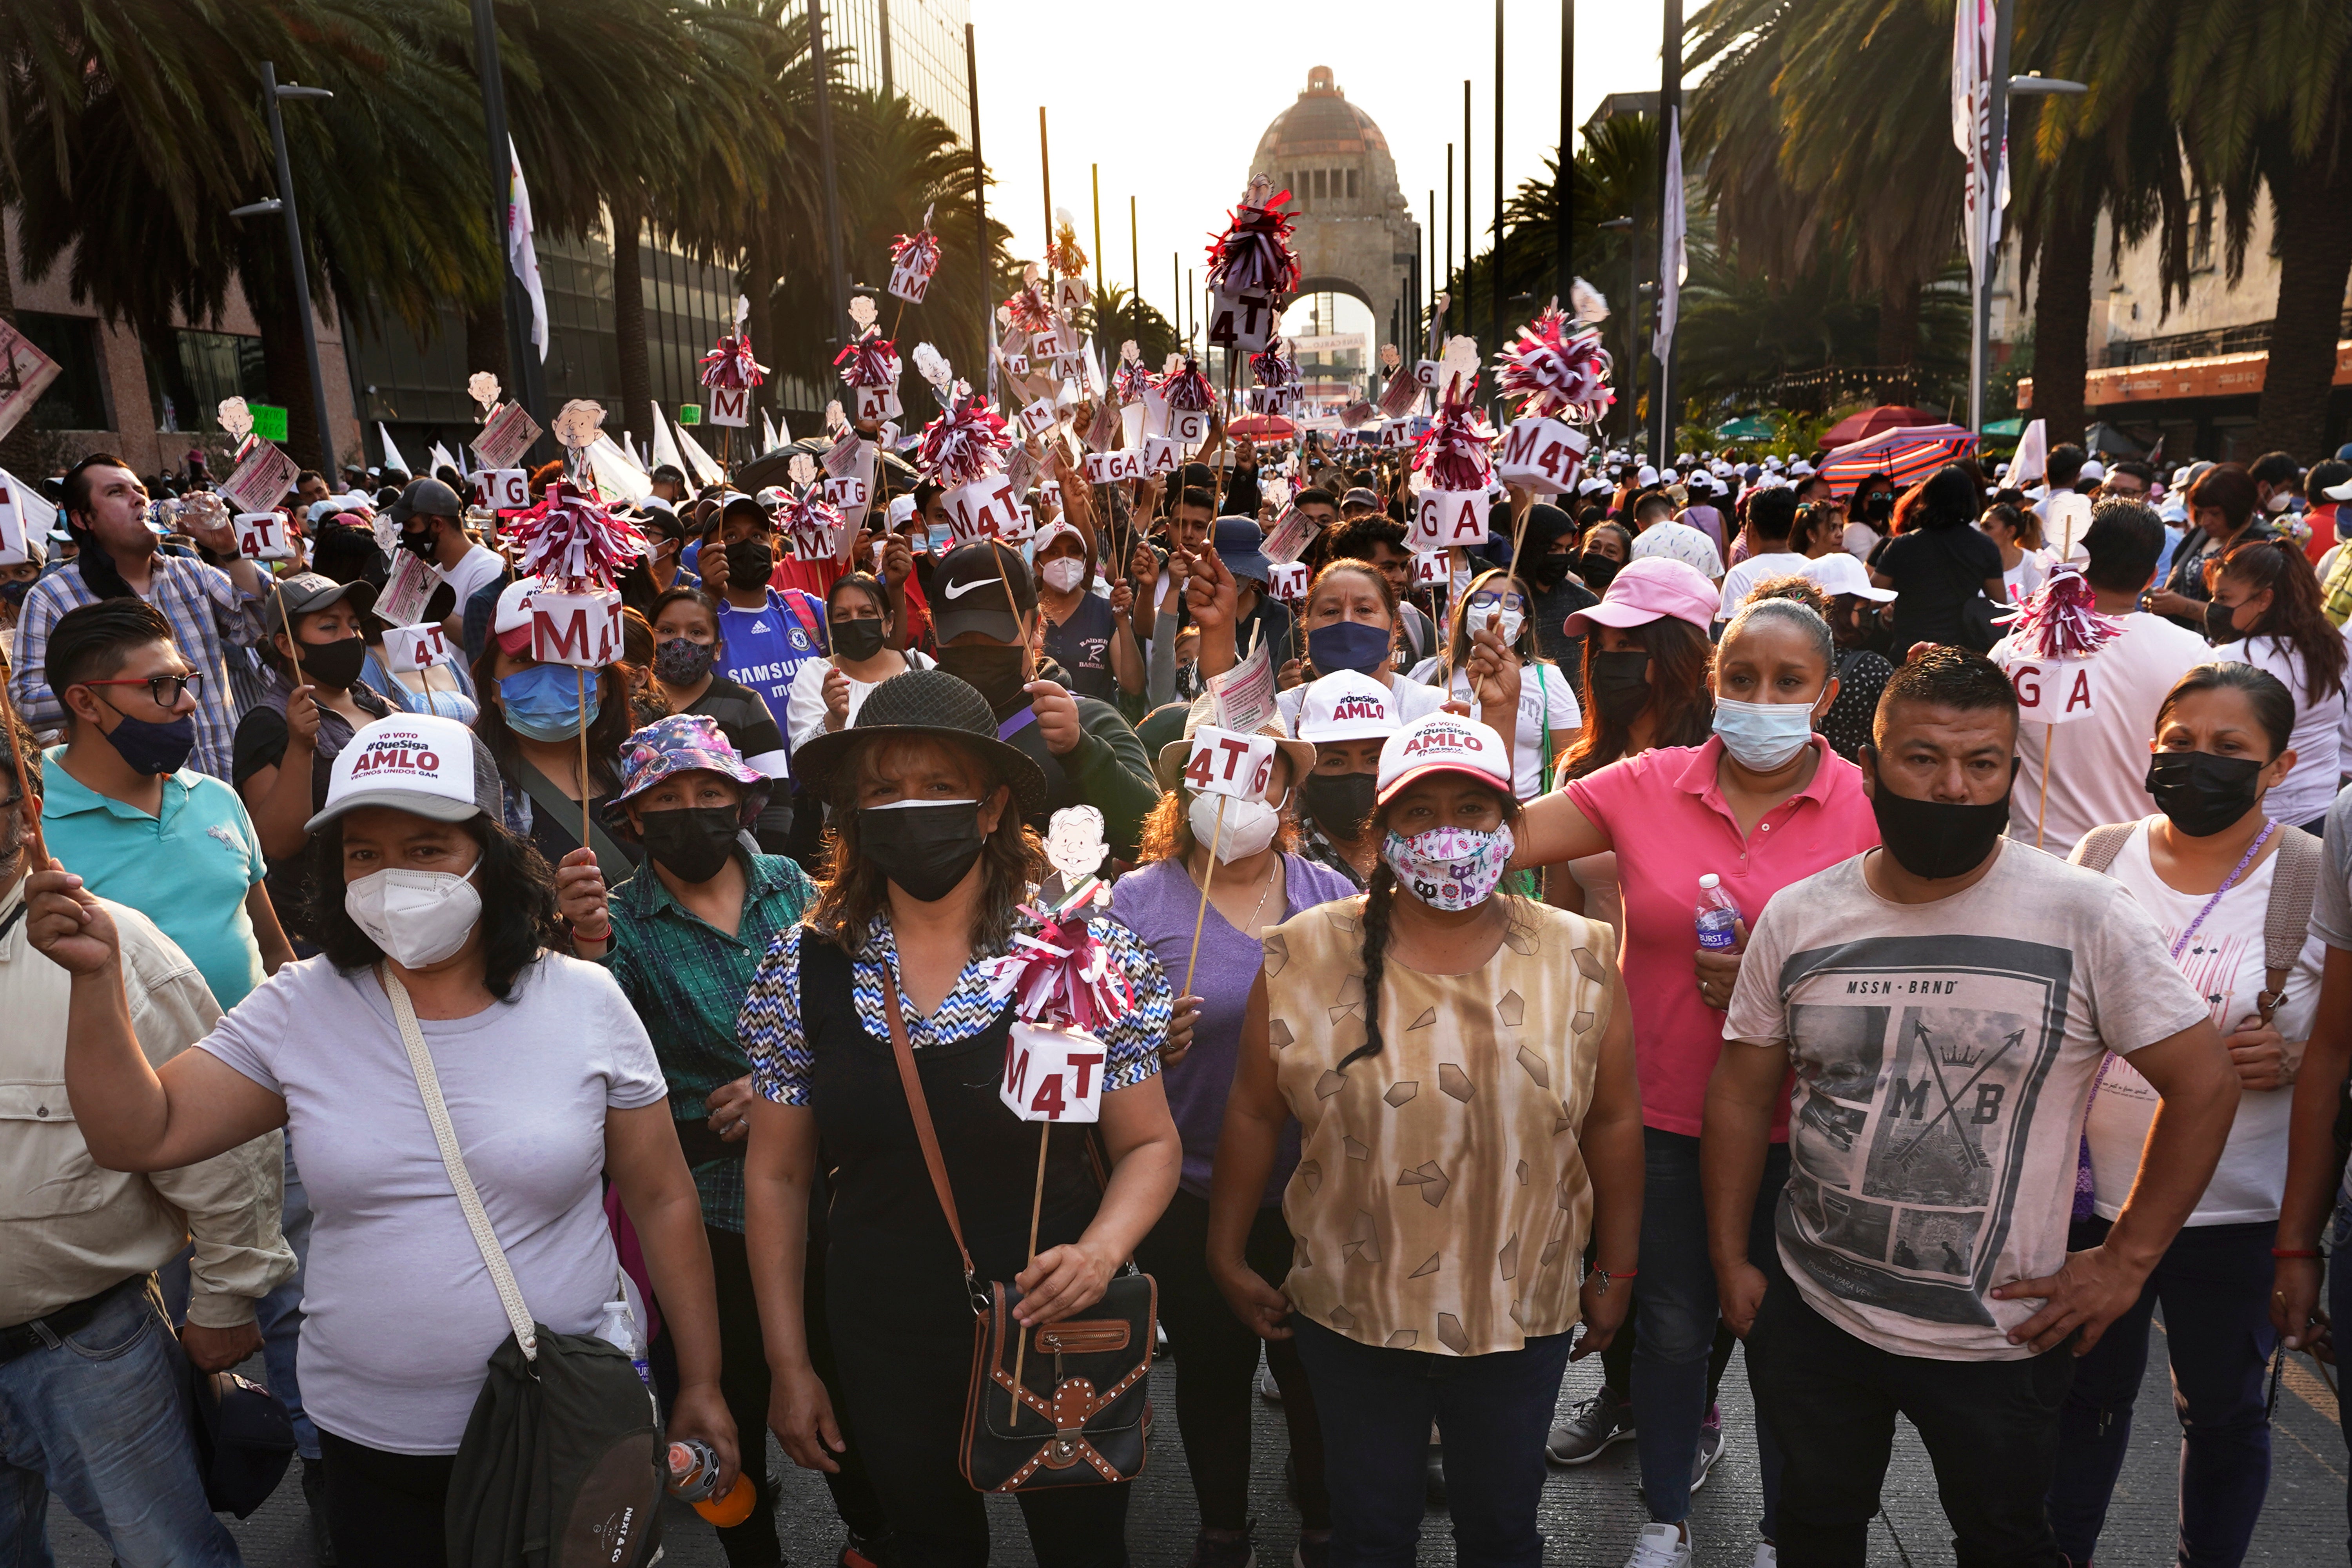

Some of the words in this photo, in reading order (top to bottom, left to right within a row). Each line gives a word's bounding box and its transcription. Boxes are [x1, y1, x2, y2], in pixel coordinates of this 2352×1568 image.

[891, 272, 899, 291] A
[903, 277, 926, 300] M
[1064, 285, 1078, 305] A
[1211, 296, 1267, 348] 4T
[1037, 337, 1057, 356] 4T
[1014, 358, 1027, 373] 4T
[1063, 356, 1074, 376] A
[1418, 367, 1432, 383] G
[715, 391, 744, 418] M
[864, 390, 889, 419] 4T
[1252, 393, 1264, 413] M
[1268, 390, 1287, 415] 4T
[1291, 387, 1303, 399] M
[1060, 408, 1072, 420] A
[1181, 417, 1197, 438] G
[1383, 423, 1406, 448] 4T
[1340, 433, 1356, 448] 4T
[1505, 426, 1541, 465] M
[1110, 457, 1122, 477] G
[1125, 455, 1138, 474] A
[1157, 446, 1174, 468] A
[1539, 441, 1584, 486] 4T
[1088, 459, 1102, 482] 4T
[474, 474, 495, 508] 4T
[506, 478, 523, 503] G
[827, 480, 849, 505] 4T
[855, 483, 866, 503] G
[1042, 488, 1060, 507] 4T
[944, 499, 975, 541] M
[978, 485, 1019, 539] 4T
[1421, 500, 1437, 537] G
[1454, 500, 1480, 538] A
[242, 519, 274, 557] 4T
[795, 531, 828, 559] M
[1420, 552, 1449, 581] 4T
[1268, 572, 1279, 595] M
[1282, 570, 1306, 599] 4T
[534, 610, 590, 661] M
[598, 602, 622, 663] 4T
[415, 627, 444, 665] 4T
[1088, 644, 1105, 662] R
[2013, 666, 2040, 708] G
[2065, 669, 2091, 713] A
[1333, 702, 1384, 721] AMLO
[1340, 696, 1379, 704] #QueSiga
[366, 740, 428, 751] #QueSiga
[1403, 733, 1483, 756] AMLO
[1415, 728, 1471, 738] #QueSiga
[351, 770, 381, 780] VECINOS
[419, 771, 438, 779] GAM
[352, 750, 439, 775] AMLO
[1185, 738, 1249, 788] 4T
[1255, 754, 1272, 793] G
[1847, 981, 1891, 994] MSSN
[1908, 981, 1954, 994] BRND
[1002, 1034, 1029, 1103] M
[1031, 1053, 1103, 1120] 4T
[1888, 1078, 1932, 1120] M
[1970, 1084, 2006, 1125] B
[1808, 1259, 1836, 1281] MUSICA
[1836, 1276, 1854, 1290] PARA
[1829, 1256, 1841, 1267] CD
[1855, 1268, 1869, 1277] MX
[620, 1507, 633, 1535] NEXT
[616, 1537, 624, 1546] &
[611, 1548, 622, 1563] CO
